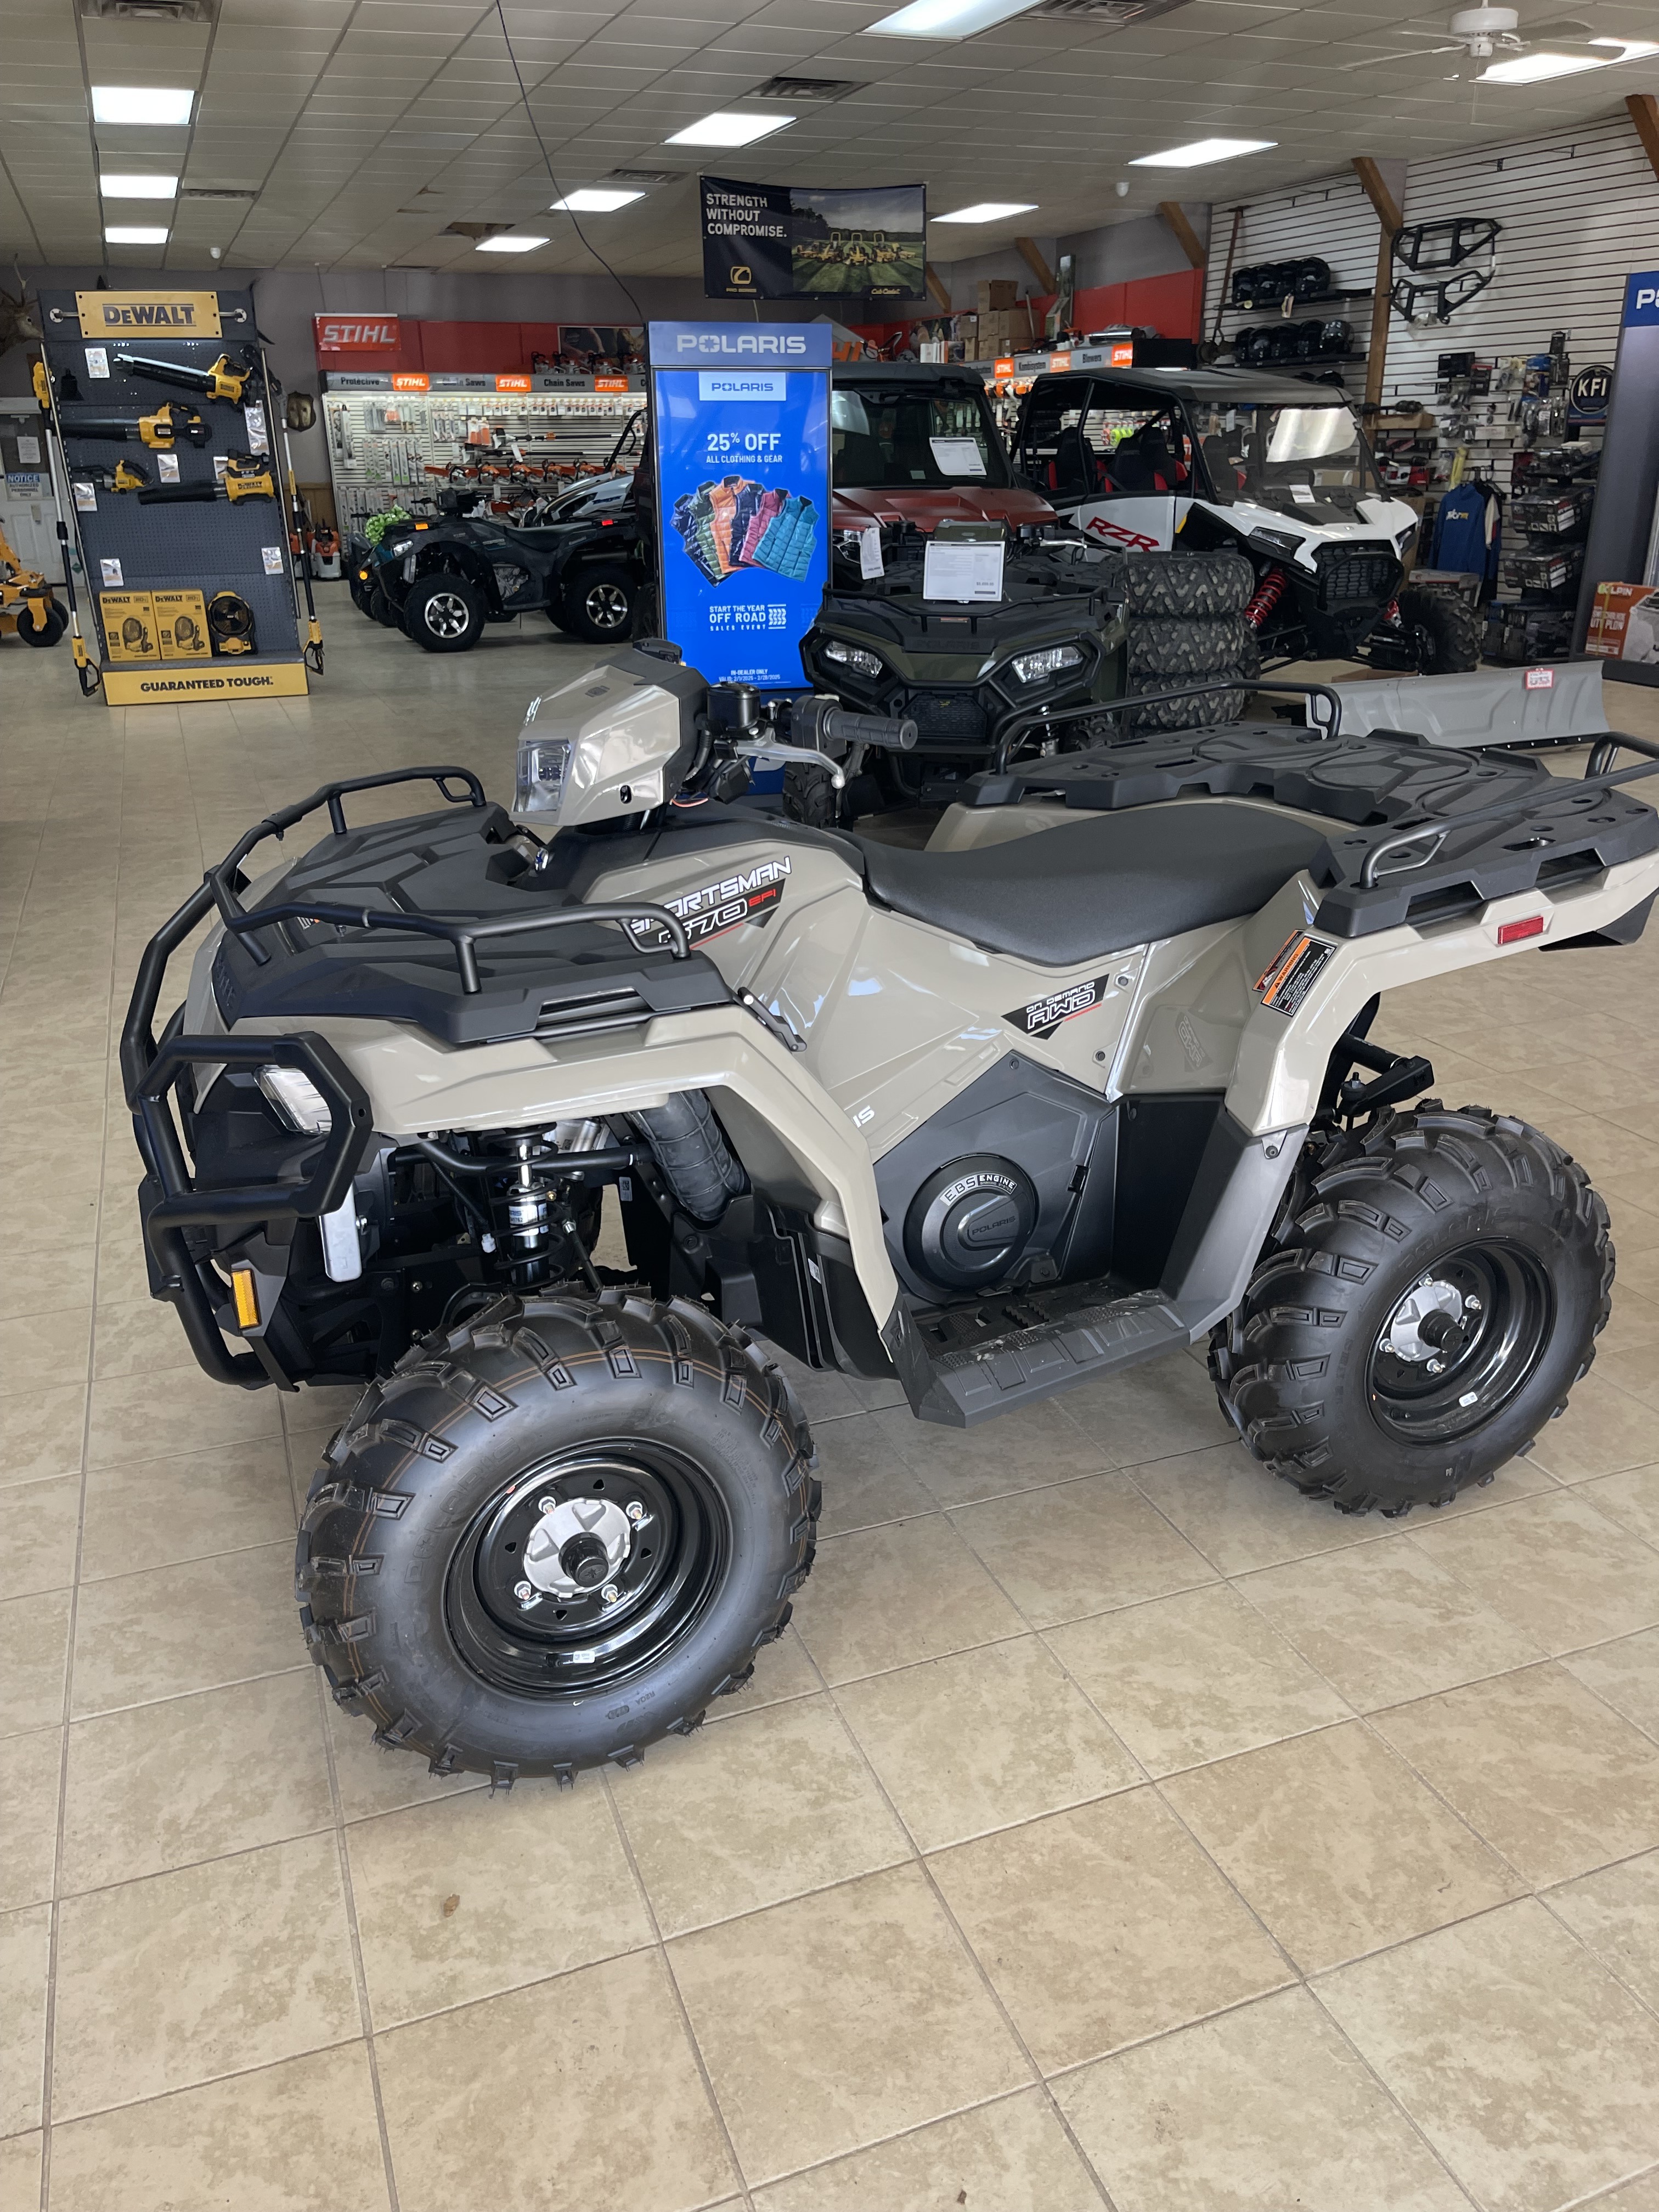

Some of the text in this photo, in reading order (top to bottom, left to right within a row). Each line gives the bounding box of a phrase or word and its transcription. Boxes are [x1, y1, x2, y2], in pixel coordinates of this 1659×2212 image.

[706, 193, 768, 207] STRENGTH
[706, 208, 760, 222] WITHOUT
[707, 223, 787, 238] COMPROMISE.
[323, 325, 396, 343] STIHL
[676, 335, 806, 354] POLARIS
[996, 364, 1012, 373] STIHL
[1052, 357, 1069, 368] STIHL
[341, 376, 380, 385] Protective
[396, 377, 426, 387] STIHL
[465, 378, 486, 386] Saws
[499, 379, 528, 388] STIHL
[544, 379, 585, 387] Chain Saws
[597, 380, 625, 388] STIHL
[712, 383, 774, 392] POLARIS
[1577, 377, 1607, 397] KFI
[707, 432, 782, 452] 25% OFF
[706, 454, 783, 464] ALL CLOTHING & GEAR
[8, 475, 40, 483] NOTICE
[1086, 516, 1160, 552] RZR
[709, 612, 766, 623] OFF ROAD
[140, 679, 224, 692] GUARANTEED
[748, 888, 777, 907] EFI
[1278, 953, 1299, 983] WARNING
[1026, 981, 1095, 1013] ON DEMAND
[1028, 988, 1096, 1030] AWD
[944, 1174, 1015, 1202] EBS ENGINE
[972, 1215, 1016, 1235] POLARIS
